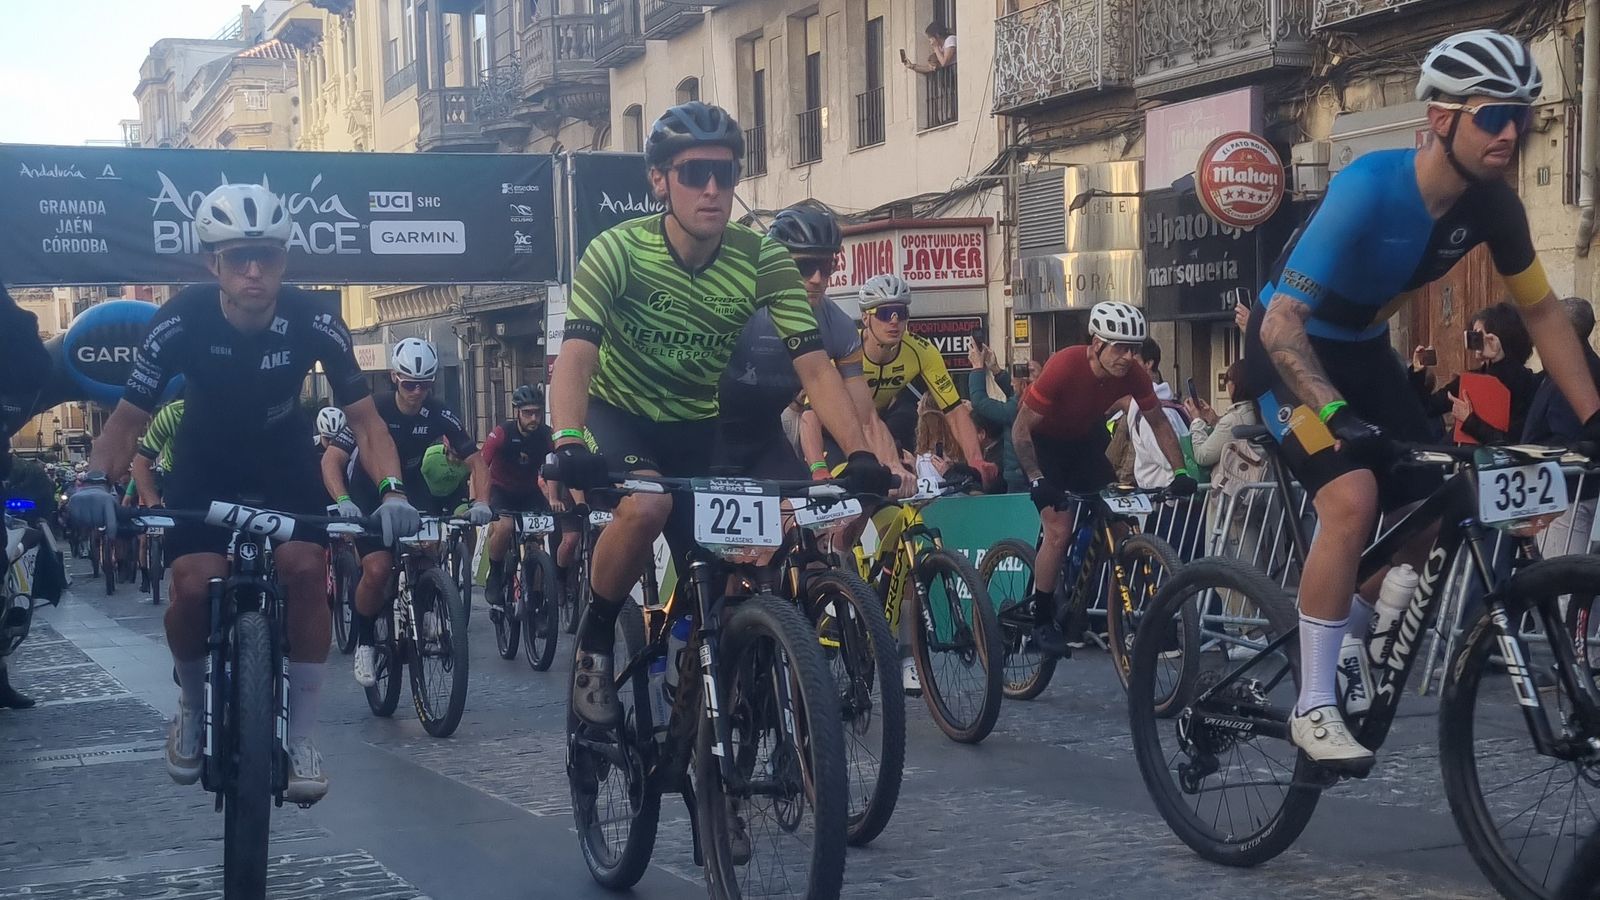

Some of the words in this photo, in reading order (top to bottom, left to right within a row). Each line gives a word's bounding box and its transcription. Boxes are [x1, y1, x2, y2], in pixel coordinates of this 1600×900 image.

[1230, 140, 1249, 150] PATO
[20, 162, 87, 179] Andalucía
[1212, 166, 1278, 186] Mahou
[148, 170, 358, 220] Ancía
[376, 195, 410, 209] UCI
[417, 196, 441, 208] SHC
[598, 191, 665, 214] Andaluc
[40, 199, 107, 216] GRANADA
[56, 215, 93, 235] JAÉN
[42, 236, 109, 254] CÓRDOBA
[154, 221, 199, 254] BI
[287, 221, 361, 254] ACE
[901, 233, 981, 248] OPORTUNIDADES
[851, 239, 894, 286] JAVIER
[903, 247, 982, 271] JAVIER
[903, 271, 931, 280] TODO
[935, 271, 948, 279] EN
[952, 269, 983, 279] TELAS
[1148, 251, 1239, 287] marisquería
[829, 274, 848, 288] LAS
[1064, 272, 1115, 291] HORA
[1221, 290, 1236, 310] 19
[631, 341, 713, 360] WIELERSPO
[933, 336, 972, 351] VIER
[1495, 466, 1555, 511] 33-2
[1113, 496, 1144, 509] 29-1
[222, 505, 282, 536] 47-2
[528, 517, 550, 530] 28-2
[709, 497, 764, 537] 22-1
[1377, 536, 1447, 706] S-WORKS
